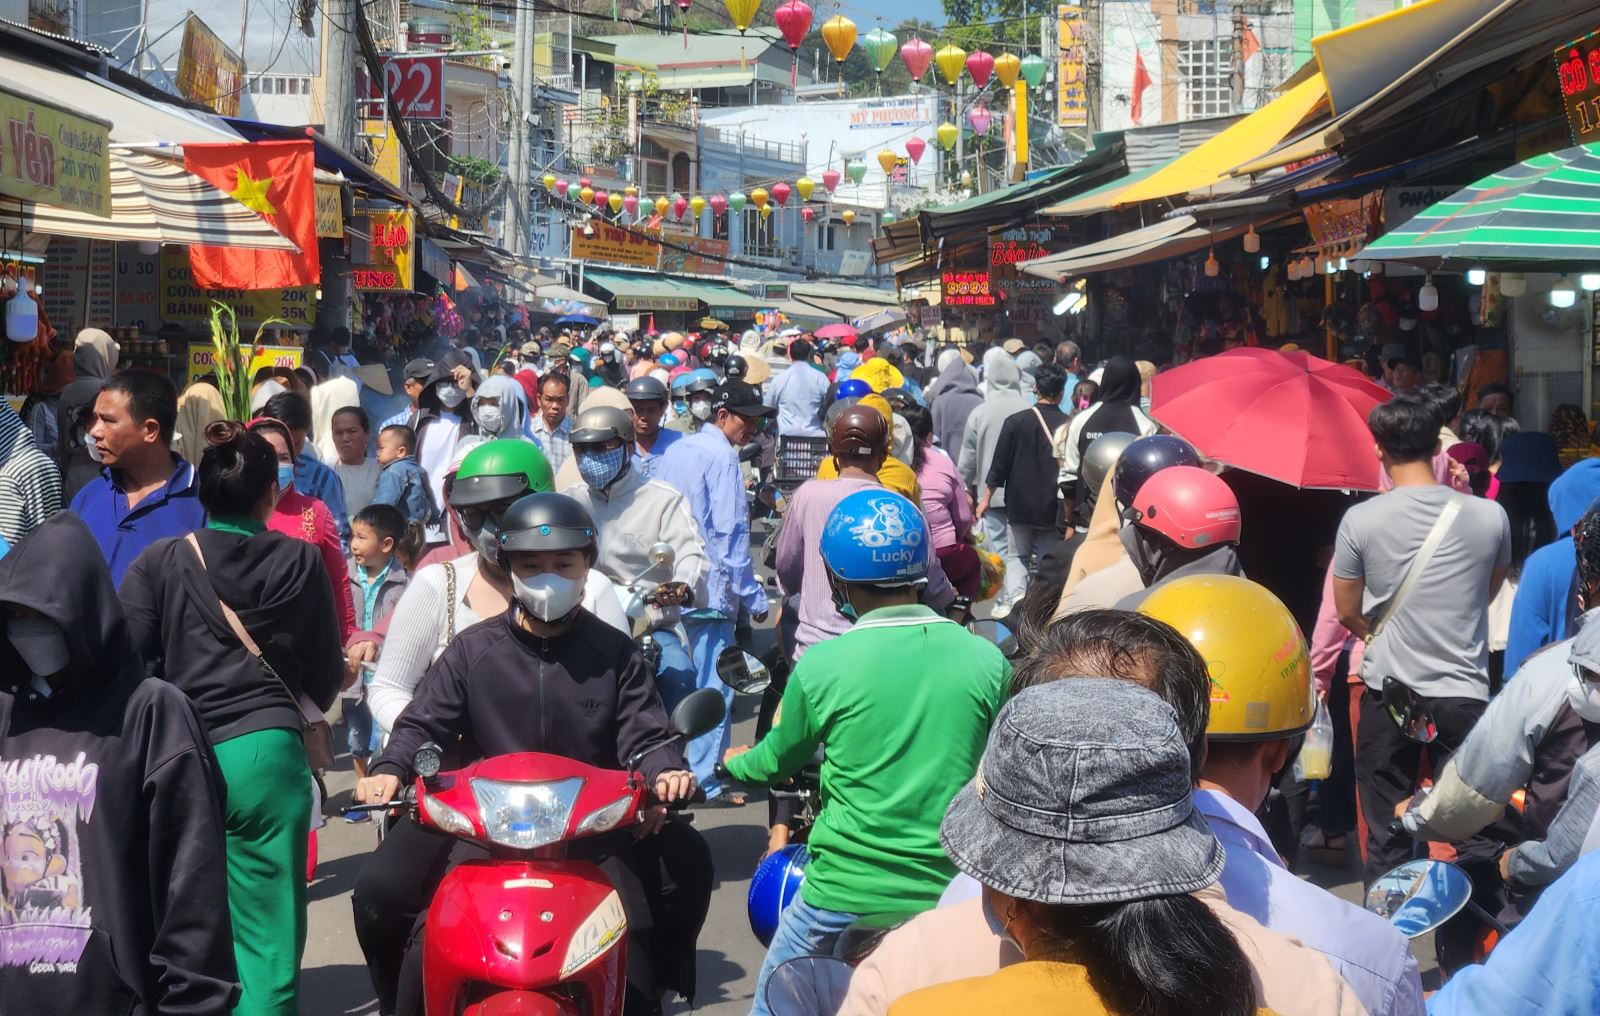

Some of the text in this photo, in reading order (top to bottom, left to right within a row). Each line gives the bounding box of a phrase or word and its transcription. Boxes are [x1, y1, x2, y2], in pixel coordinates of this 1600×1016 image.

[1560, 47, 1587, 95] CÔ
[8, 108, 54, 191] Yến
[991, 241, 1026, 267] Bảo
[136, 262, 155, 275] 30
[353, 271, 396, 287] UNG
[281, 290, 308, 302] 20K
[166, 301, 208, 316] BÁNH
[281, 307, 308, 320] 35K
[274, 357, 295, 368] 20K
[872, 548, 915, 563] Lucky
